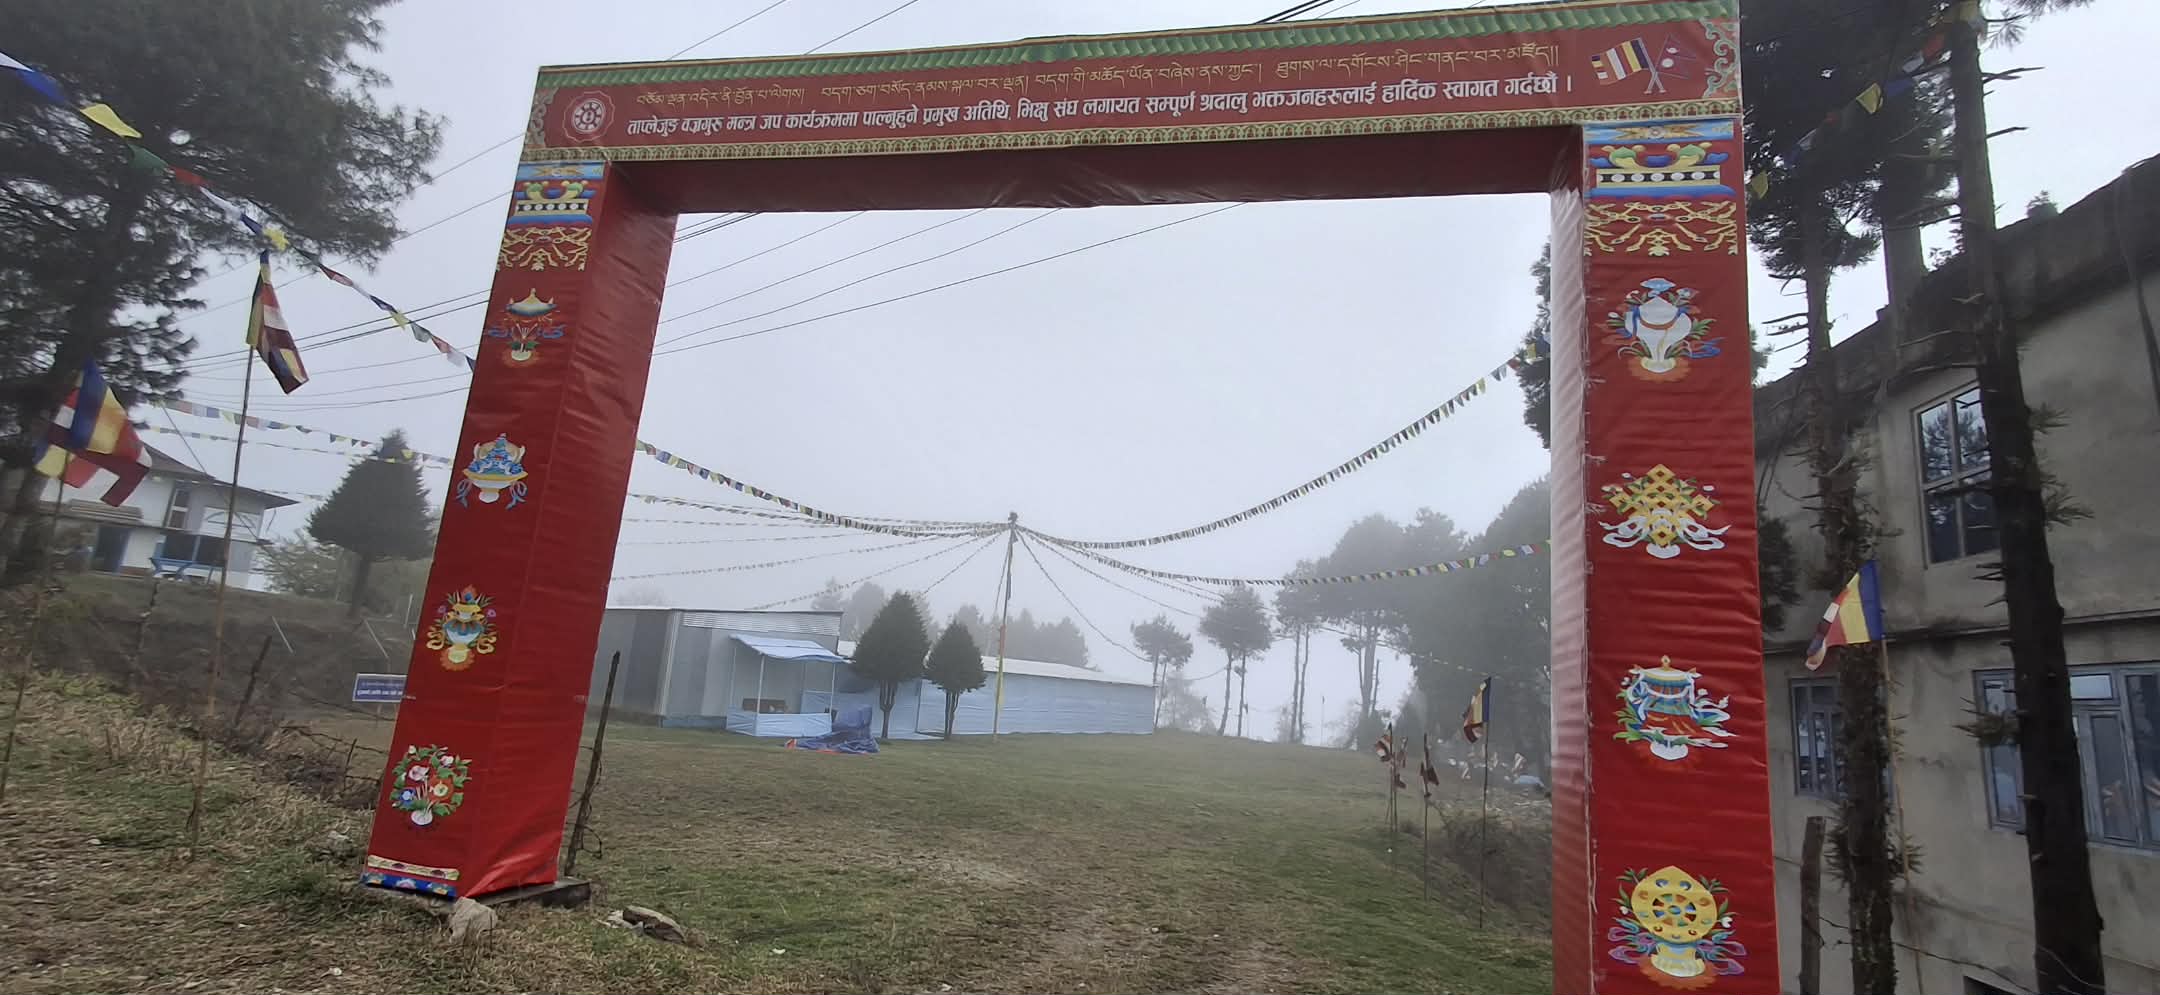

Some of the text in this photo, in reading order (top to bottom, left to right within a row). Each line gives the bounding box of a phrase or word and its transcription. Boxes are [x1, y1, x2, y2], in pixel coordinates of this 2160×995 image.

[627, 115, 680, 137] ताप्लेजुङ
[726, 114, 757, 132] मन्त्र
[759, 113, 783, 130] जप
[785, 109, 859, 130] कार्यक्रममा
[923, 106, 960, 126] प्रमुख
[1017, 97, 1048, 121] भिक्षु
[1054, 98, 1078, 118] संघ
[1083, 97, 1141, 115] लगायत
[1146, 90, 1196, 117] सम्पूर्ण
[1382, 78, 1437, 103] हार्दिक
[1443, 80, 1499, 99] स्वागत
